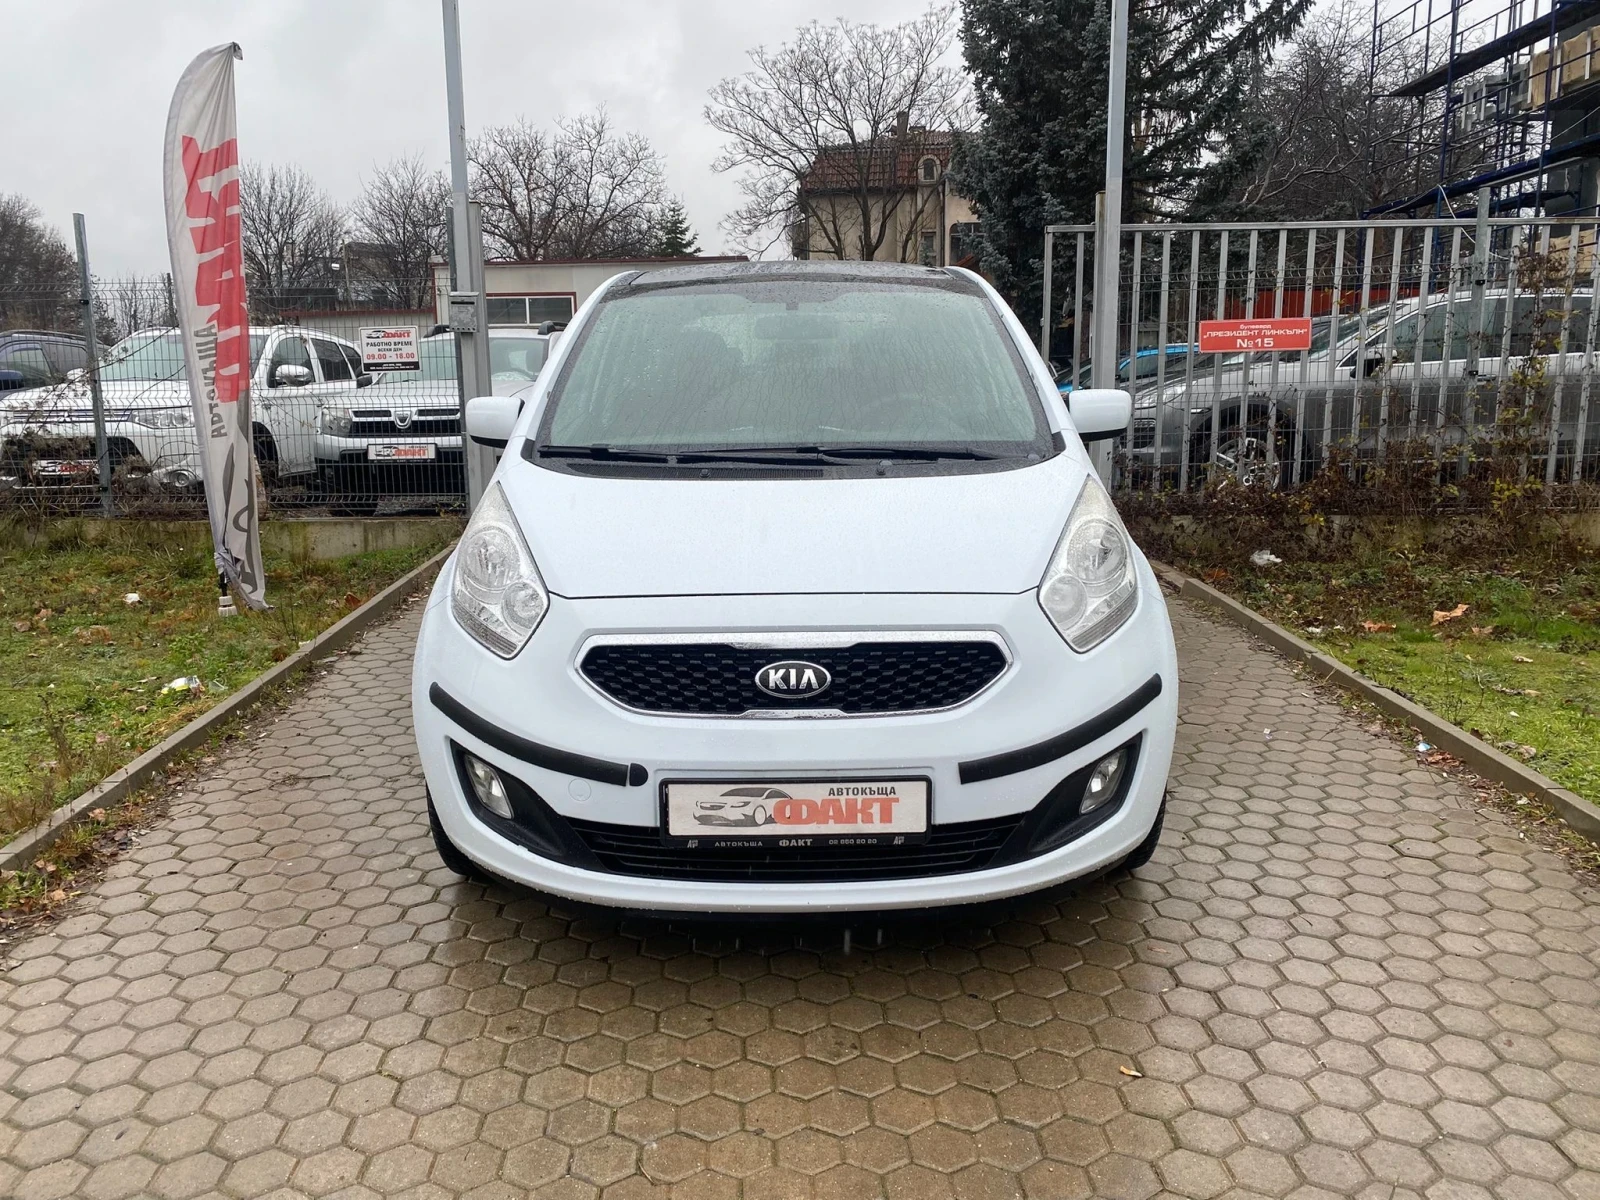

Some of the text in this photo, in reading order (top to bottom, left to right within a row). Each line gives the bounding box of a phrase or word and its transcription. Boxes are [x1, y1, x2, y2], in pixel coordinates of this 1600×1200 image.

[768, 668, 819, 690] KIA
[828, 786, 897, 797] АВТОКЪЩА
[773, 798, 899, 824] ФАКТ
[778, 838, 813, 847] ФАКТ
